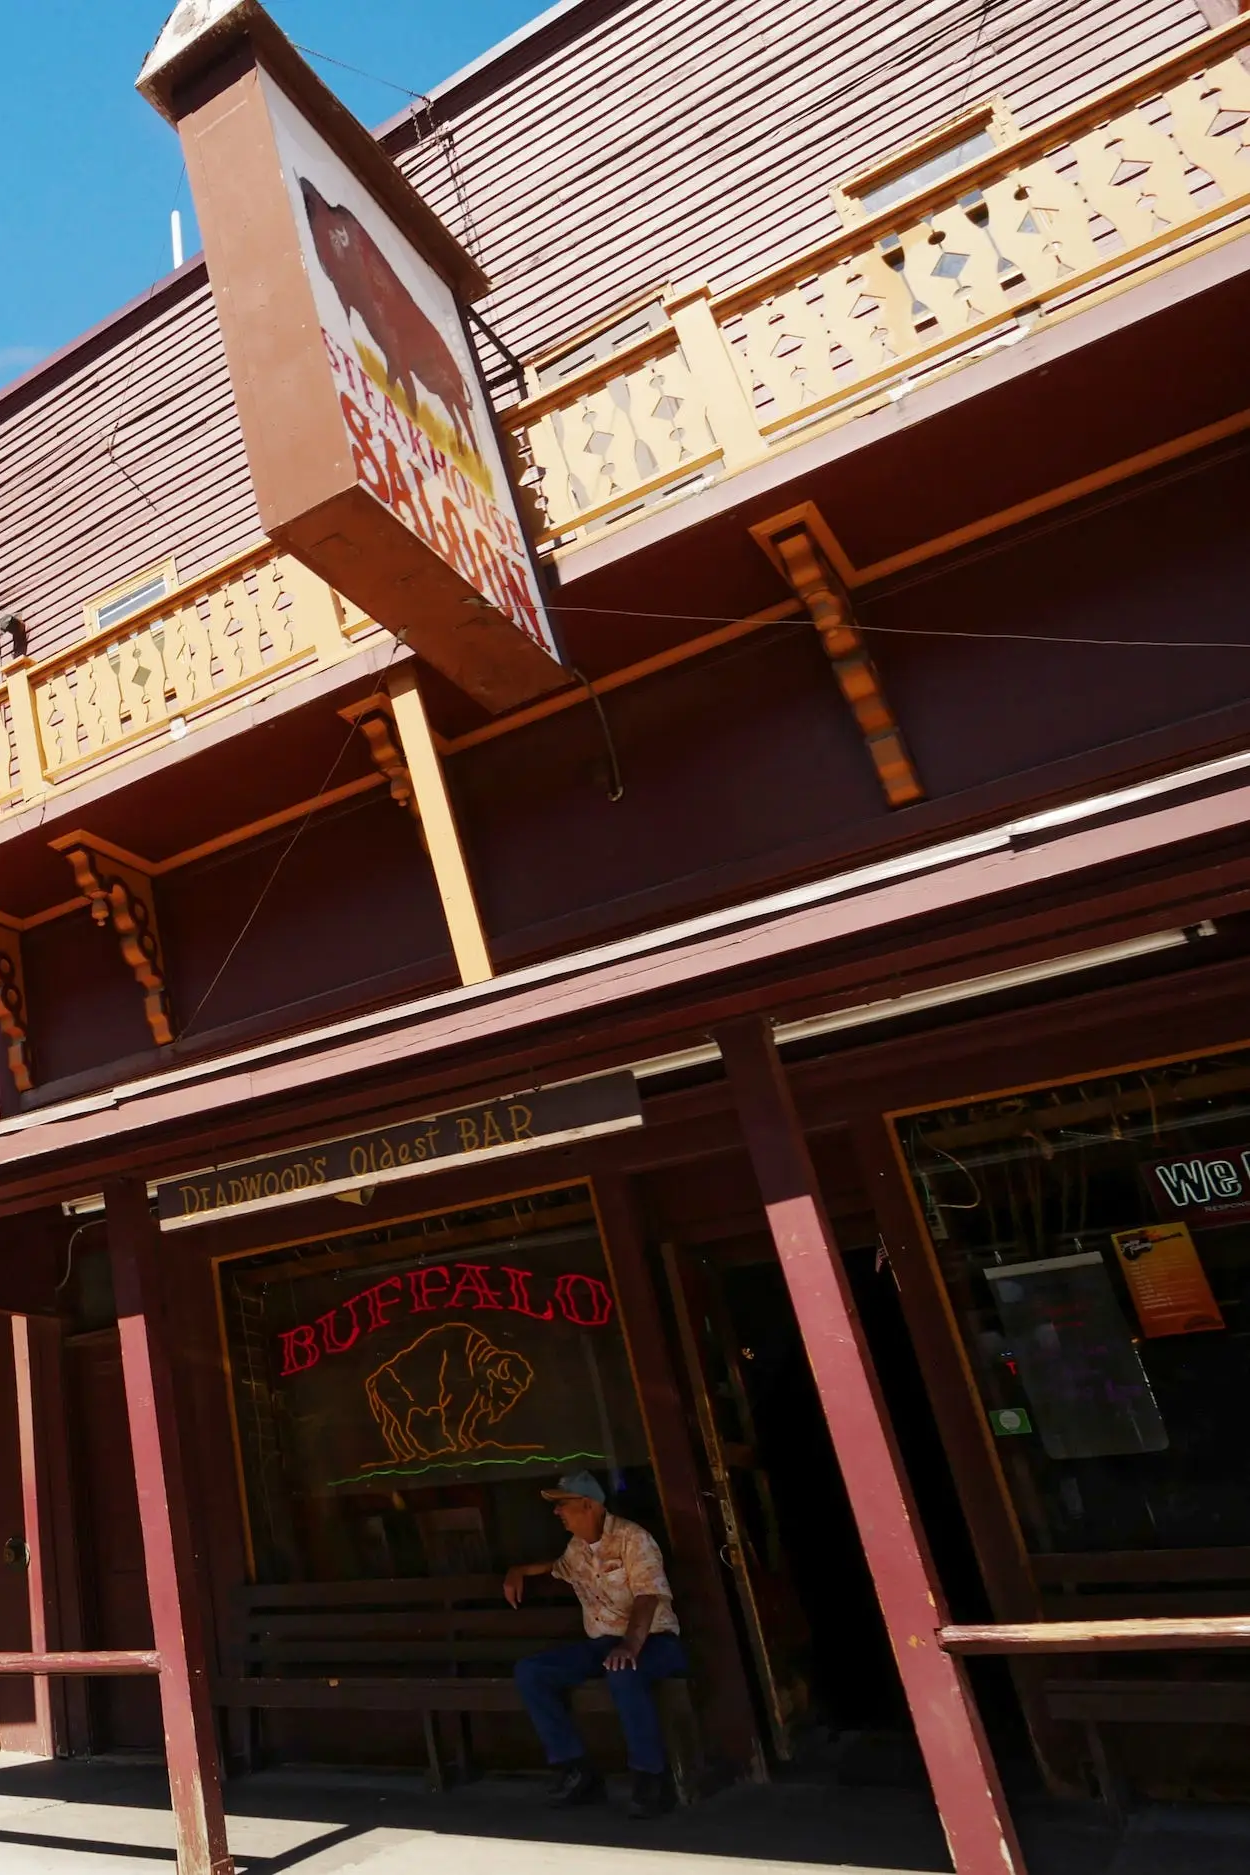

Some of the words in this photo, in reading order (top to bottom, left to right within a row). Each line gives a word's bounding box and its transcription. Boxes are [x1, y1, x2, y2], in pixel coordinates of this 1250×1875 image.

[321, 326, 526, 559] STEAKHOUSE
[339, 391, 550, 650] SALOON
[179, 1156, 327, 1221] DEADWOOD'S
[349, 1126, 440, 1180] Oldest
[456, 1104, 535, 1155] BAR
[1155, 1160, 1242, 1206] We
[278, 1263, 612, 1376] BUFFALO
